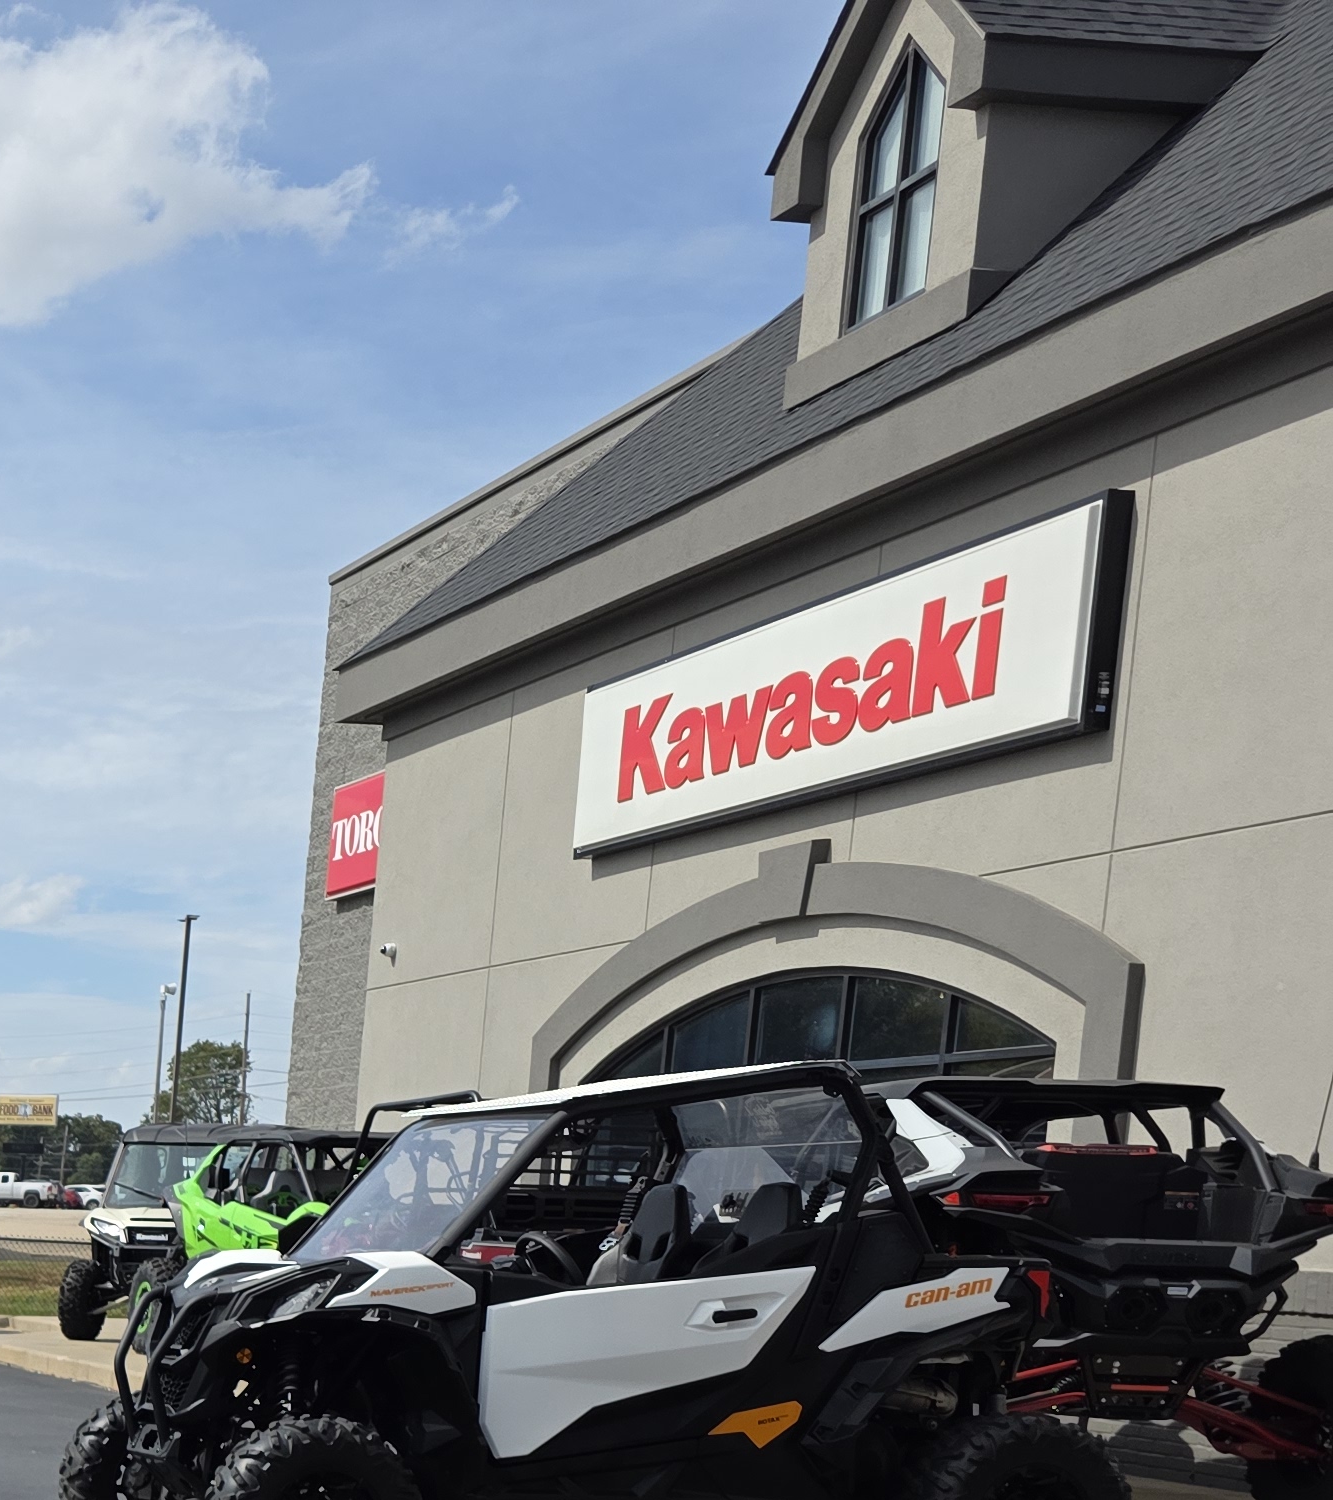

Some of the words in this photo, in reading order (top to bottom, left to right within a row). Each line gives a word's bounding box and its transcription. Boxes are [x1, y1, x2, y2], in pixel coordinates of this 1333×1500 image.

[617, 574, 1008, 804] Kawasaki
[0, 1103, 19, 1116] FOOD
[32, 1104, 54, 1116] BANK
[370, 1285, 427, 1298] MAVERICK
[904, 1277, 993, 1309] can-am
